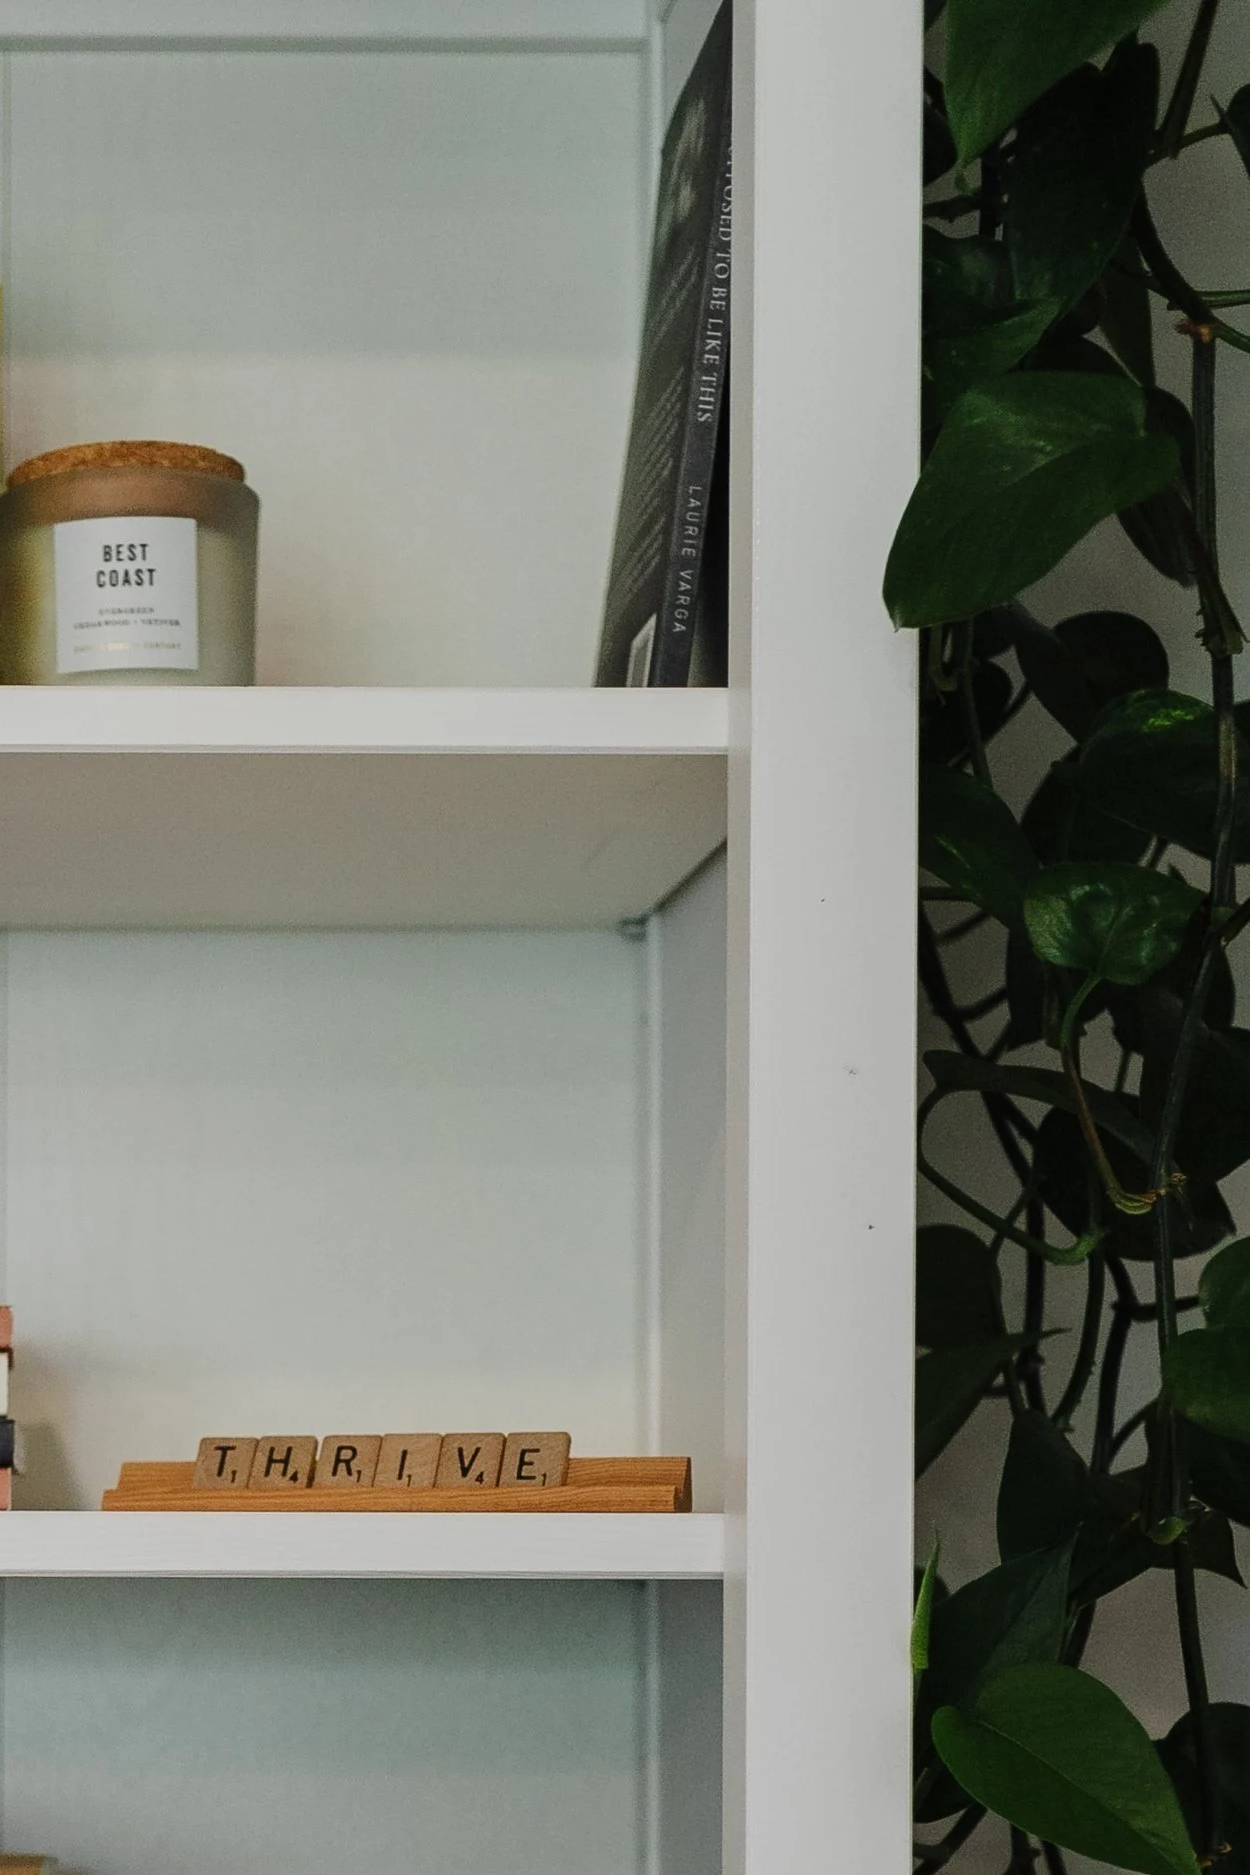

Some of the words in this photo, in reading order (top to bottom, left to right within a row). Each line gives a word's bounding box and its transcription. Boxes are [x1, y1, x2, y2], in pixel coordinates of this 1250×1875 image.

[709, 287, 727, 313] BE
[703, 319, 723, 365] LIKE
[697, 373, 718, 423] THIS
[681, 486, 702, 557] LAURIE
[103, 544, 149, 562] BEST
[96, 569, 157, 588] COAST
[673, 569, 694, 633] VARGA
[213, 1445, 544, 1482] THRIVE
